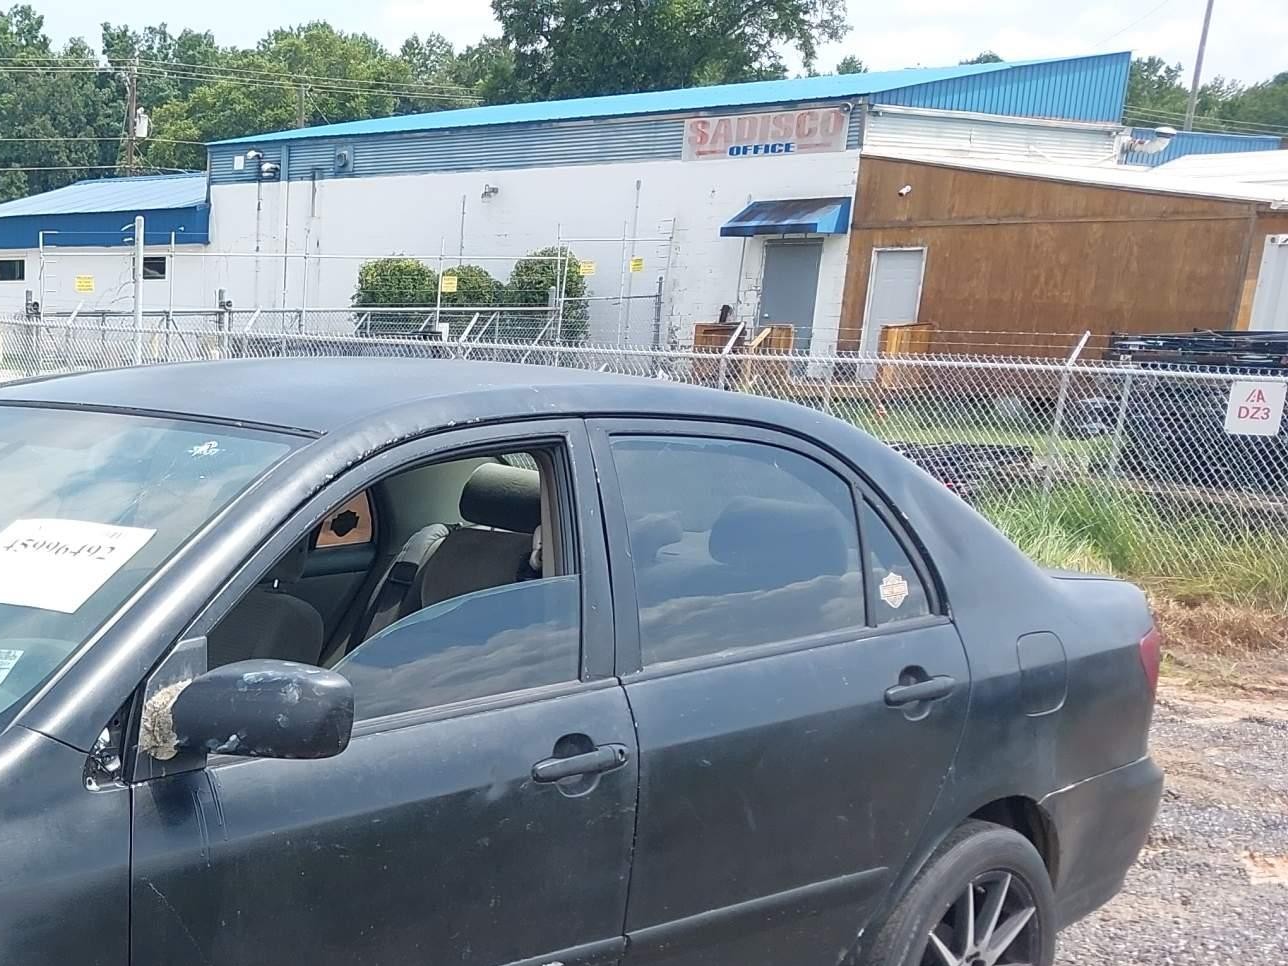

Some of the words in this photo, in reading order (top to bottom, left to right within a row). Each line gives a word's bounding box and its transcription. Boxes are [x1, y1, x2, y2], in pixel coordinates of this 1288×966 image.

[687, 110, 845, 145] SADISCO
[728, 142, 796, 157] OFFICE
[1237, 406, 1271, 420] DZ3
